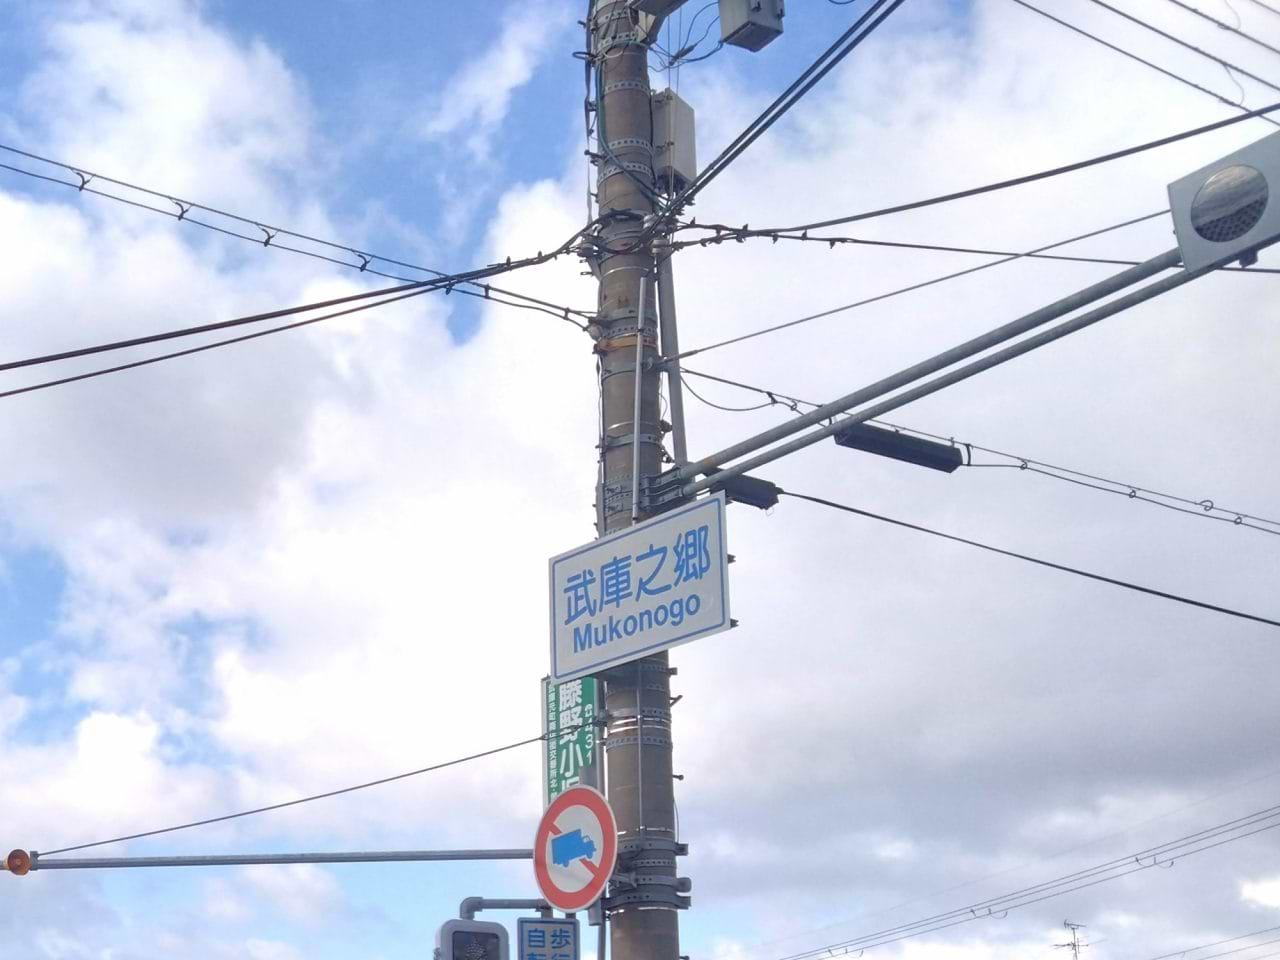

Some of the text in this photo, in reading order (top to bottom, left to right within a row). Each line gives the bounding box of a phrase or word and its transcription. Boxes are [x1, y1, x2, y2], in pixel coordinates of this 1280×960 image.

[564, 525, 711, 626] 武庫之郷
[573, 594, 701, 653] Mukonogo
